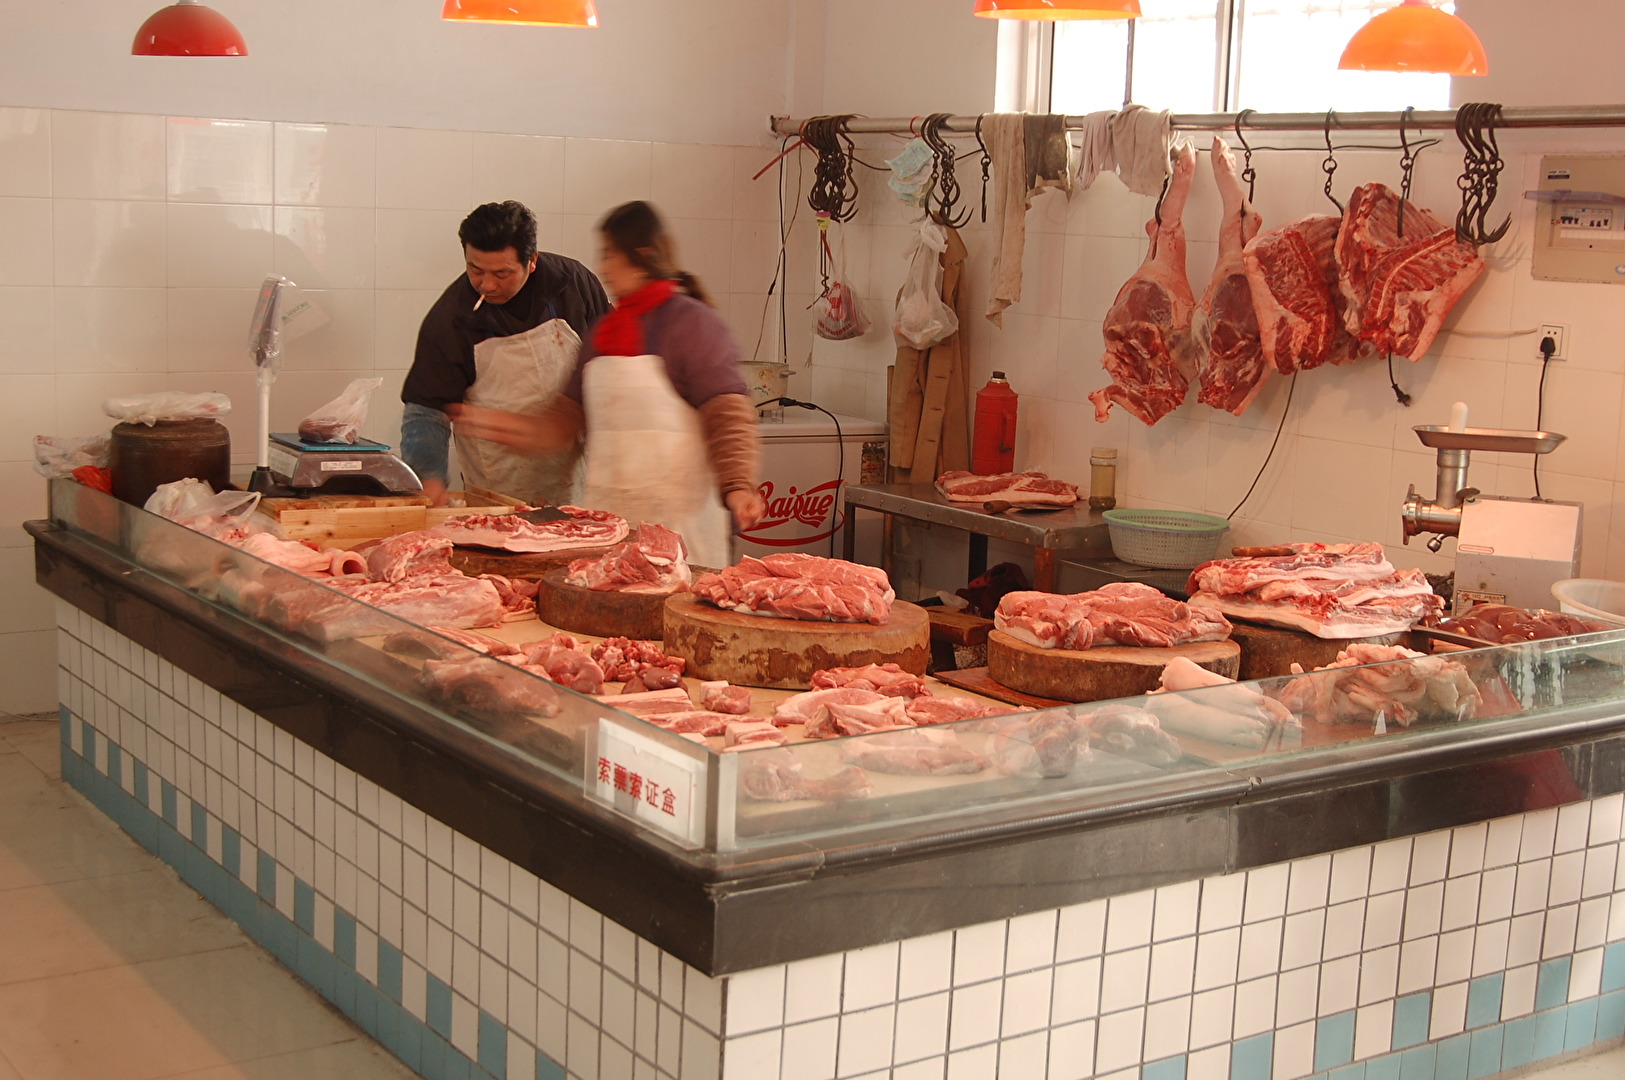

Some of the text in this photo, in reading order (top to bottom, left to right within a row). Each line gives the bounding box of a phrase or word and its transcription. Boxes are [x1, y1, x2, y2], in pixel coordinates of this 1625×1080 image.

[597, 756, 677, 817] 索票索证盒
